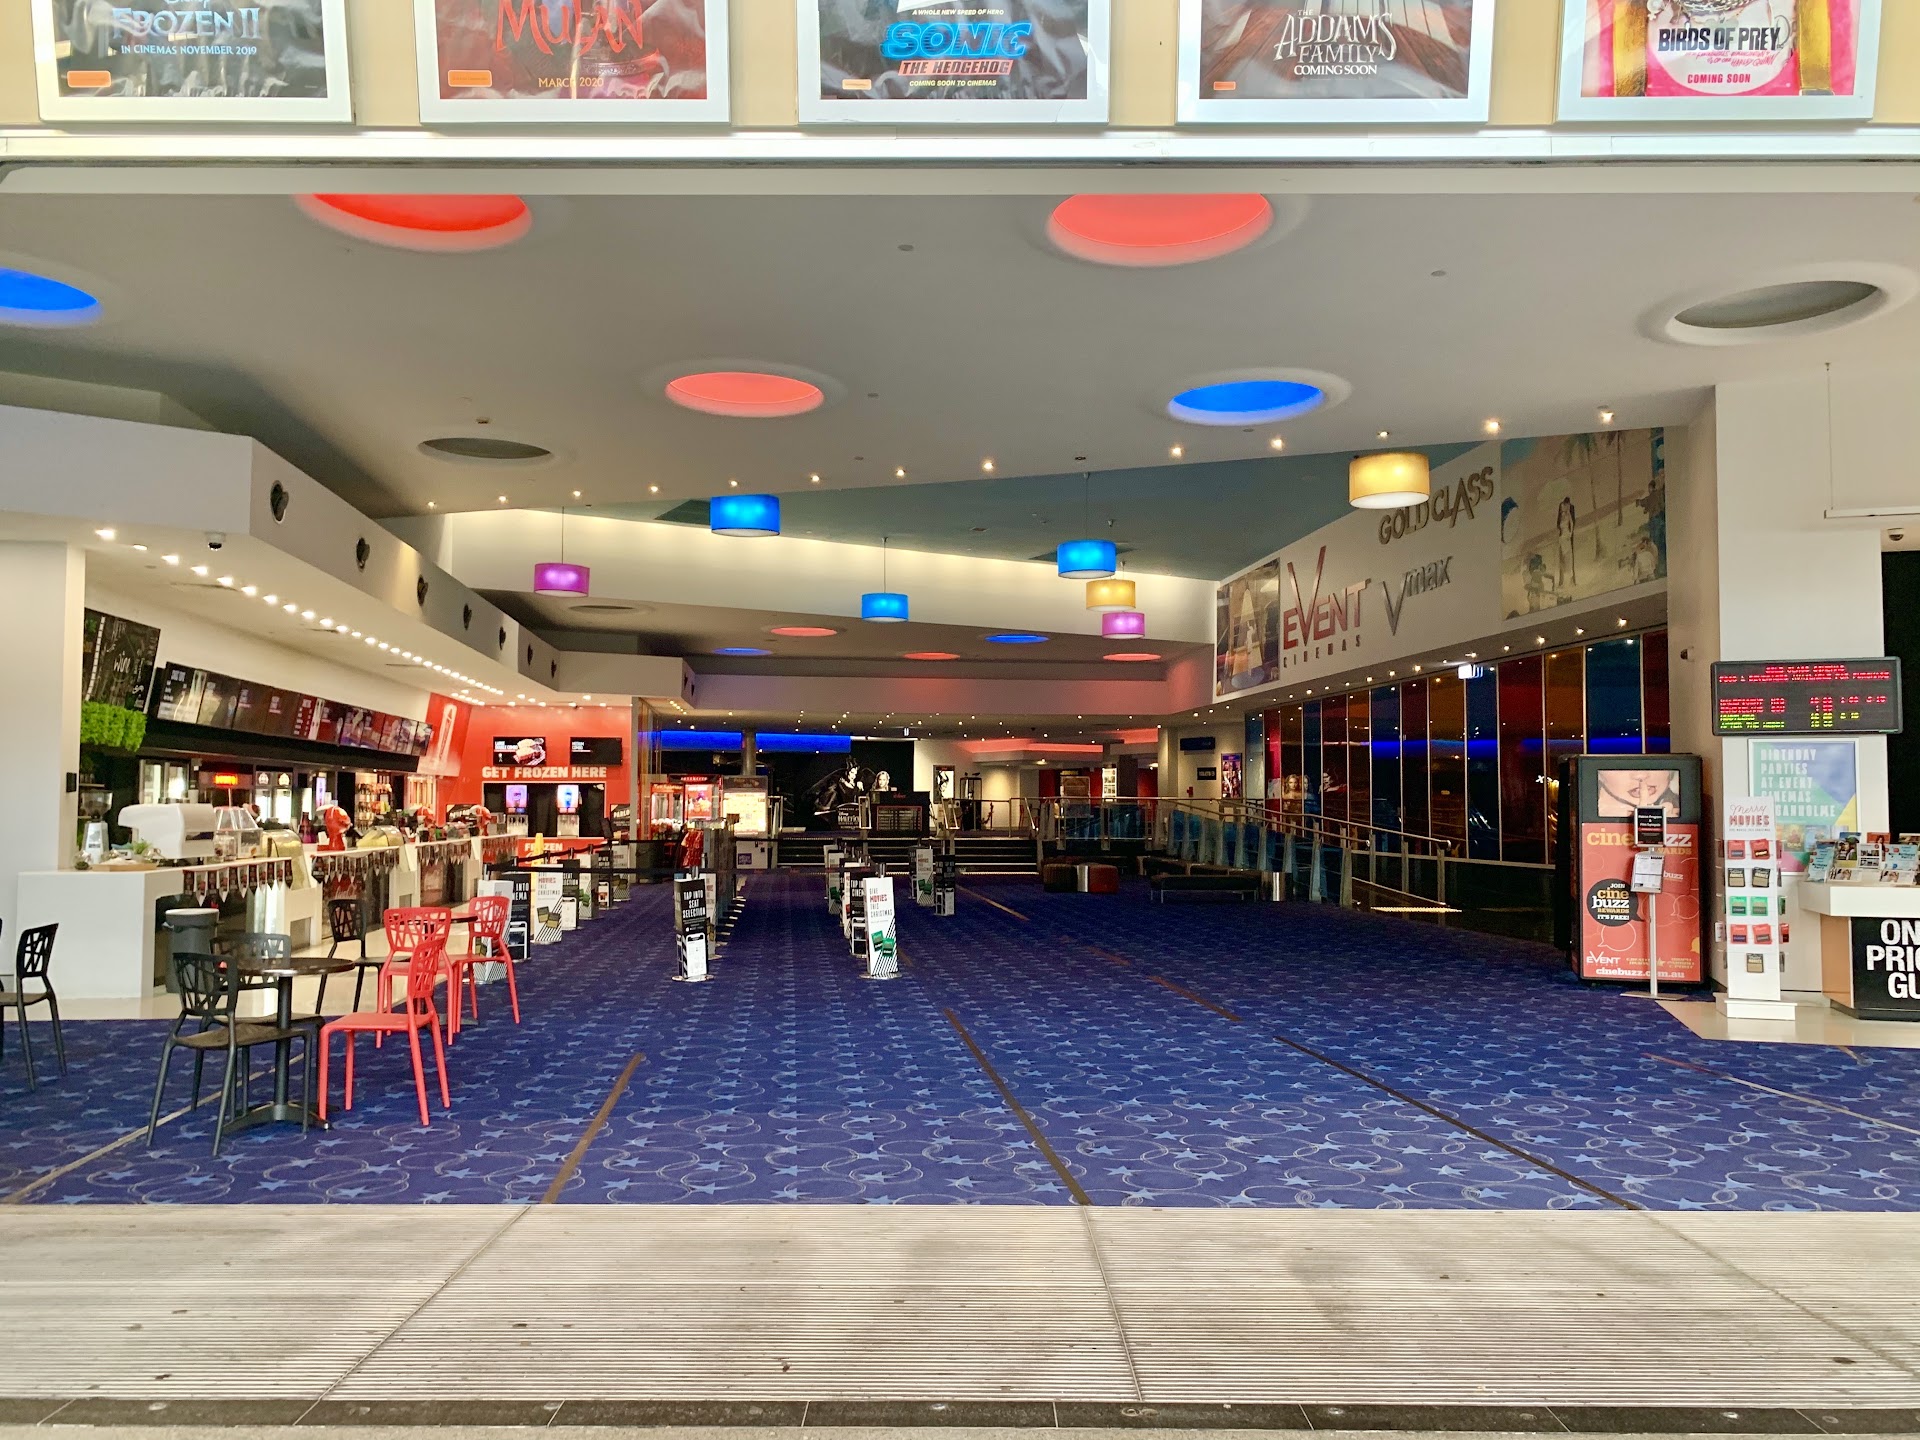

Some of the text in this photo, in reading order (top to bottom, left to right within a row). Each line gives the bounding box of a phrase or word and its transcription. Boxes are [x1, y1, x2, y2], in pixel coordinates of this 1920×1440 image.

[112, 7, 262, 39] FROZEN II
[496, 0, 643, 55] MULAN
[883, 22, 1032, 58] SONIC
[1273, 12, 1397, 61] ADDAMS
[1658, 27, 1781, 51] BIRDS OF PREY
[121, 45, 257, 55] IN CINEMAS NOVEMBER 2019
[1297, 44, 1376, 63] FAMILY
[903, 61, 1010, 74] THE HEDGEHOG
[1294, 65, 1377, 75] COMING SOON
[579, 77, 604, 88] 2020
[1687, 73, 1751, 83] COMING SOON
[1378, 466, 1494, 545] GOLD CLASS
[1283, 545, 1371, 650] EVENT
[1382, 556, 1453, 637] Vmax
[1283, 634, 1361, 668] CINEMAS
[1761, 748, 1816, 761] BIRTHDAY
[482, 766, 607, 778] GET FROZEN HERE
[1761, 762, 1808, 775] PARTIES
[1761, 777, 1813, 788] AT EVENT
[1730, 804, 1767, 816] Merry
[1773, 804, 1836, 817] GANHOLME
[1729, 815, 1770, 826] MOVIES
[1586, 828, 1692, 847] cinezz
[524, 843, 563, 851] FRZEN
[684, 890, 704, 900] TAP INTO
[870, 894, 887, 902] MOVIES
[1597, 887, 1629, 899] cine
[689, 899, 699, 908] SEAT
[1592, 896, 1630, 909] buzz
[683, 907, 705, 918] SELECTION
[871, 909, 892, 918] CHRISTMAS
[1881, 919, 1920, 945] ON
[1586, 951, 1621, 964] EVENT
[1866, 945, 1920, 972] PRI
[1596, 967, 1685, 978] cinebuzz.cm.au
[1887, 972, 1920, 999] GU
